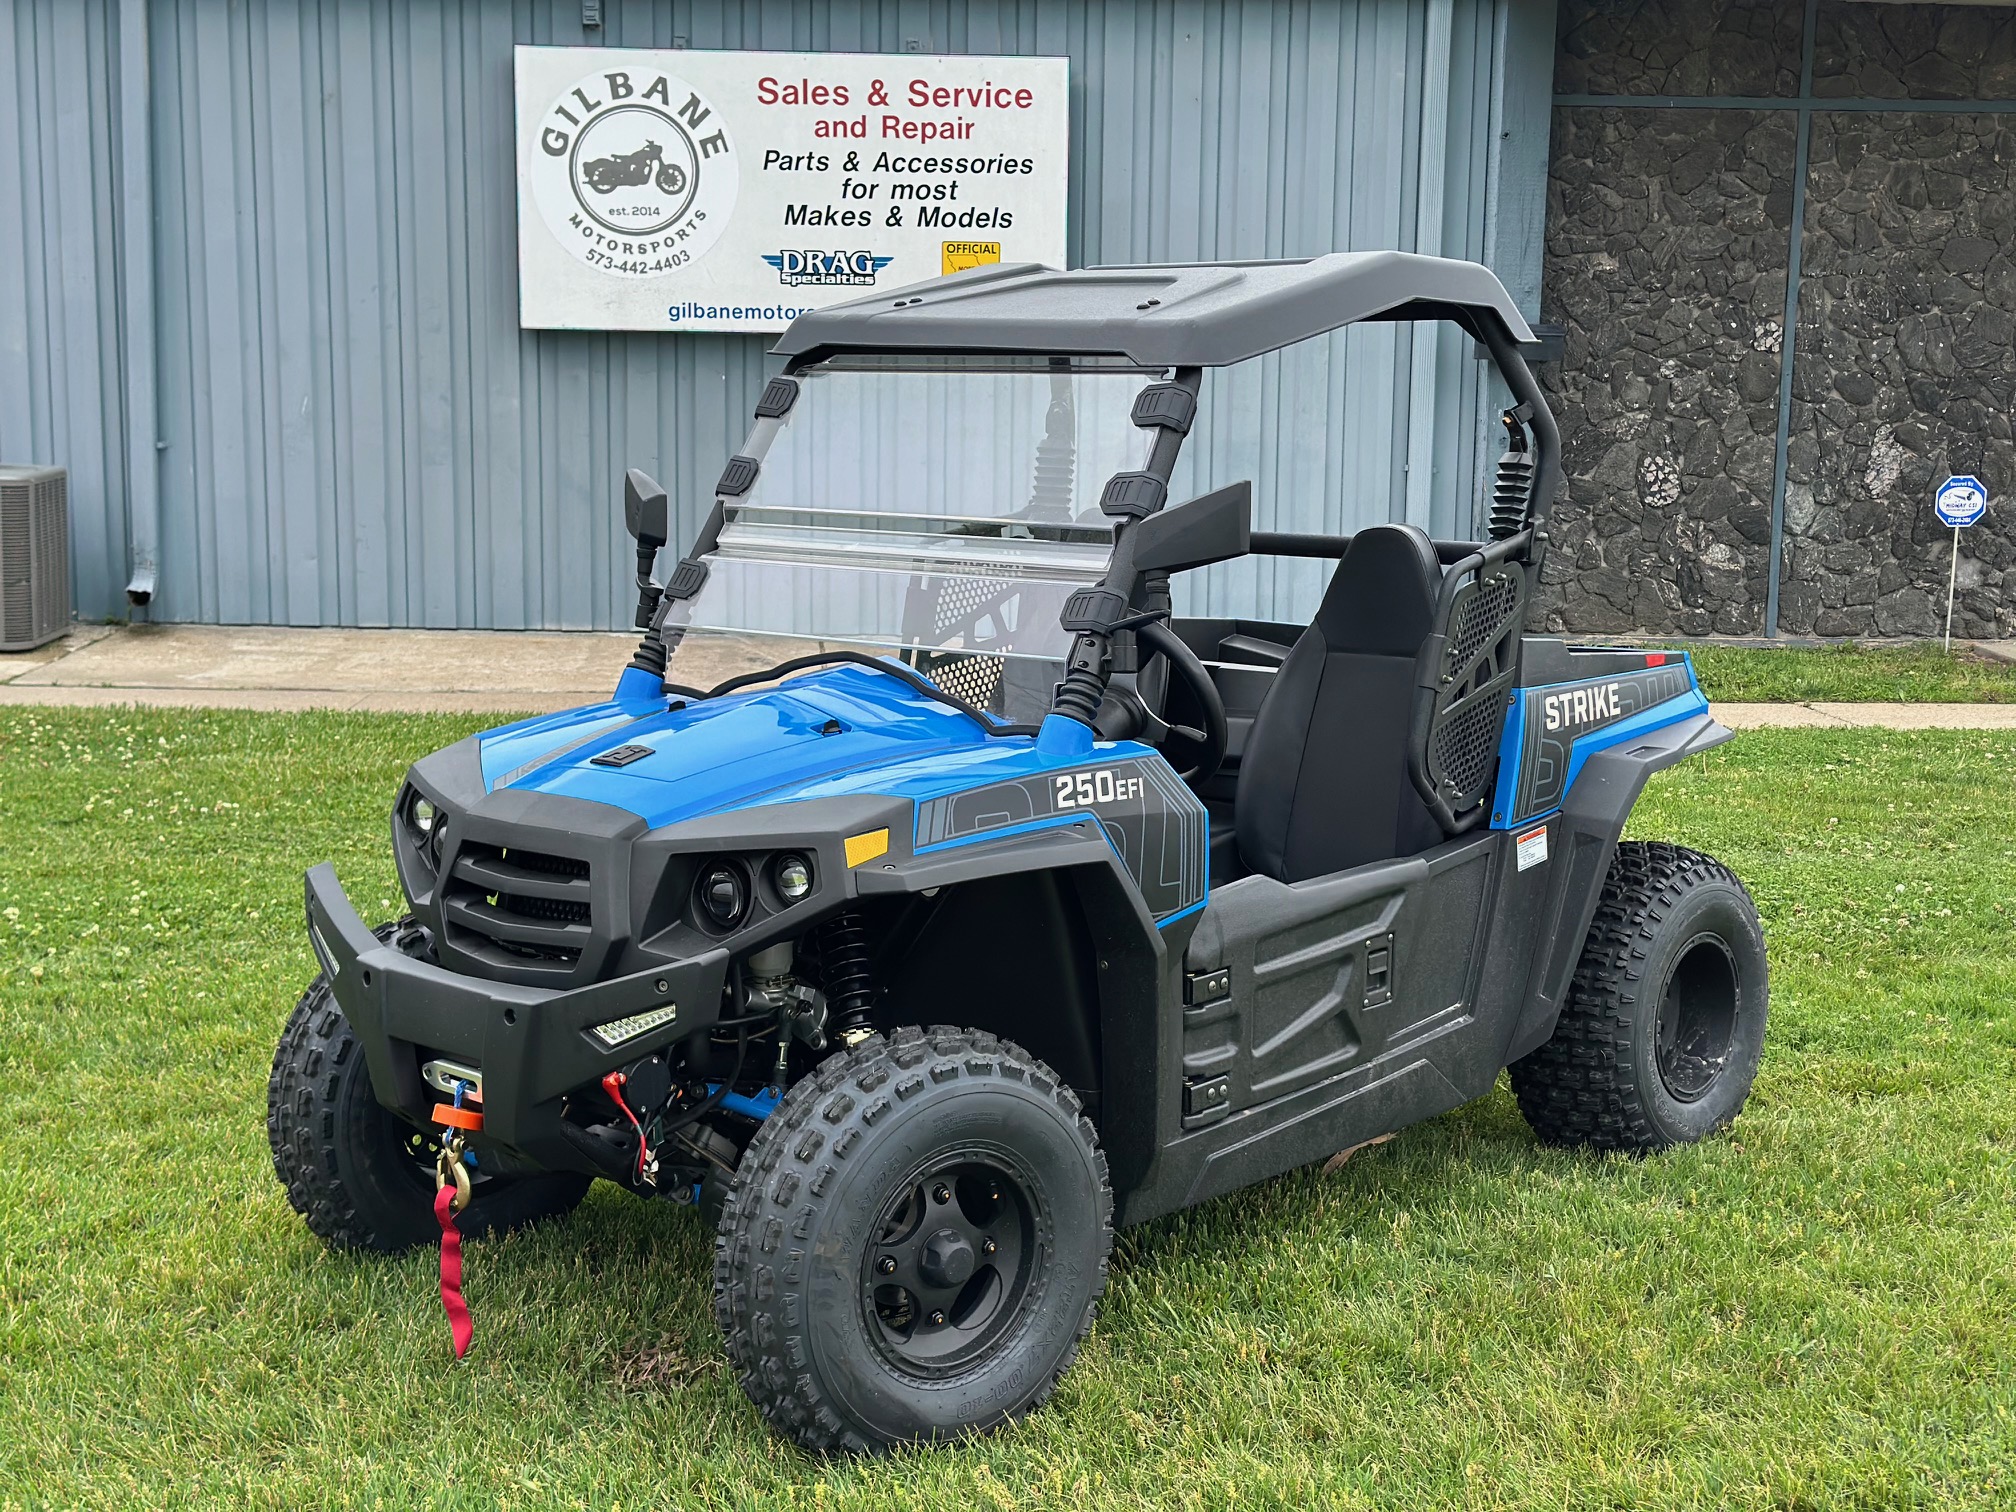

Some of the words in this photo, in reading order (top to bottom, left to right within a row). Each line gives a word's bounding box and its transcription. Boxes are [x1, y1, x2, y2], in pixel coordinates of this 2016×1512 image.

[757, 76, 850, 106] Sales
[867, 78, 890, 107] &
[907, 79, 1034, 109] Service
[541, 72, 729, 159] GILBANE
[814, 114, 867, 139] and
[881, 114, 976, 145] Repair
[762, 149, 830, 172] Parts
[842, 150, 861, 173] &
[871, 151, 1034, 175] Accessories
[841, 177, 880, 200] for
[890, 179, 959, 201] most
[608, 208, 630, 217] est.
[631, 206, 661, 217] 2014
[784, 204, 872, 227] Makes
[884, 205, 904, 228] &
[916, 206, 1014, 229] Models
[568, 209, 707, 255] MOTORSPORTS
[585, 248, 691, 275] 573-442-4403
[946, 243, 997, 255] OFFICIAL
[780, 250, 874, 275] DRAG
[780, 272, 875, 286] Specialties
[1545, 683, 1621, 731] STRIKE
